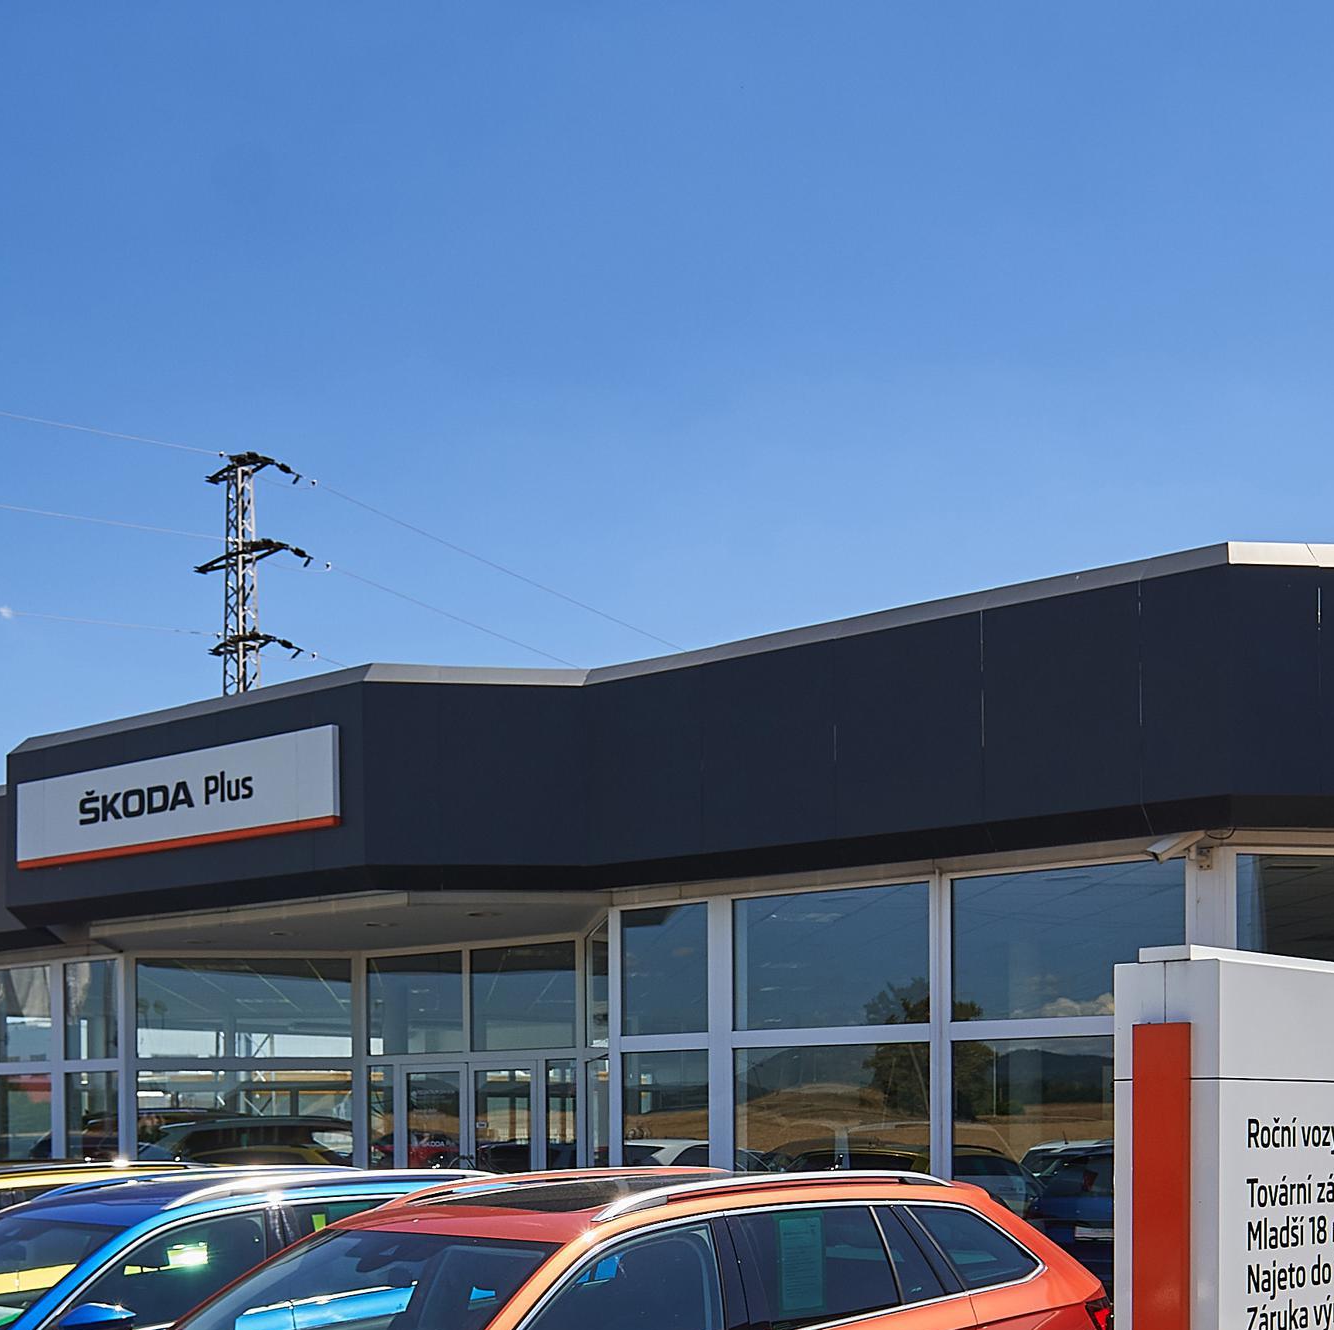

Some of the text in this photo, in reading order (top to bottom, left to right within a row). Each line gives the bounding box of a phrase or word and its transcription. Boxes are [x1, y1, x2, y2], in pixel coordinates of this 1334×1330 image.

[79, 770, 254, 826] ŠKODA Plus
[1247, 1116, 1297, 1149] Roční
[1246, 1174, 1313, 1208] Tovární
[1247, 1215, 1305, 1252] Mladší
[1308, 1215, 1327, 1245] 18
[1247, 1259, 1306, 1301] Najeto
[1311, 1253, 1332, 1286] do
